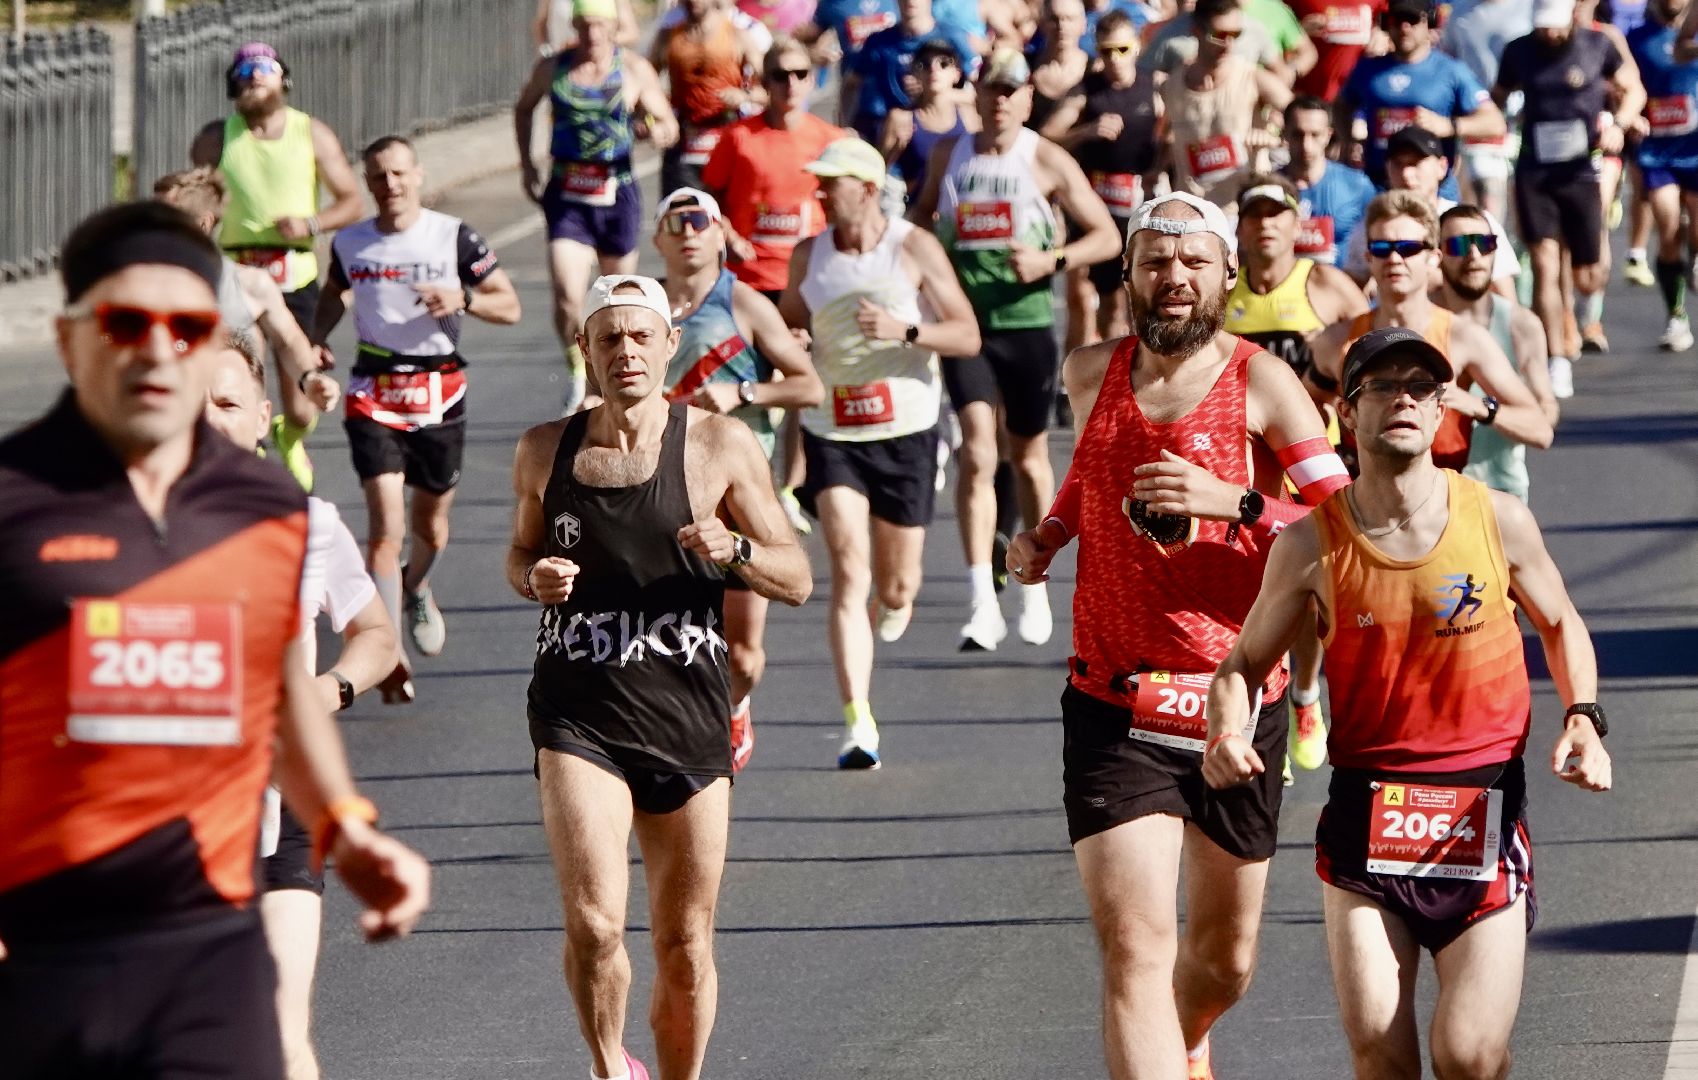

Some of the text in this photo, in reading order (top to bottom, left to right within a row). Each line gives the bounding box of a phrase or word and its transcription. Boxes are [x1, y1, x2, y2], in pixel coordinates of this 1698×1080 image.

[1435, 621, 1486, 638] RUN.MIPT
[89, 640, 225, 689] 2065
[1388, 792, 1399, 802] A
[1382, 810, 1476, 842] 2064
